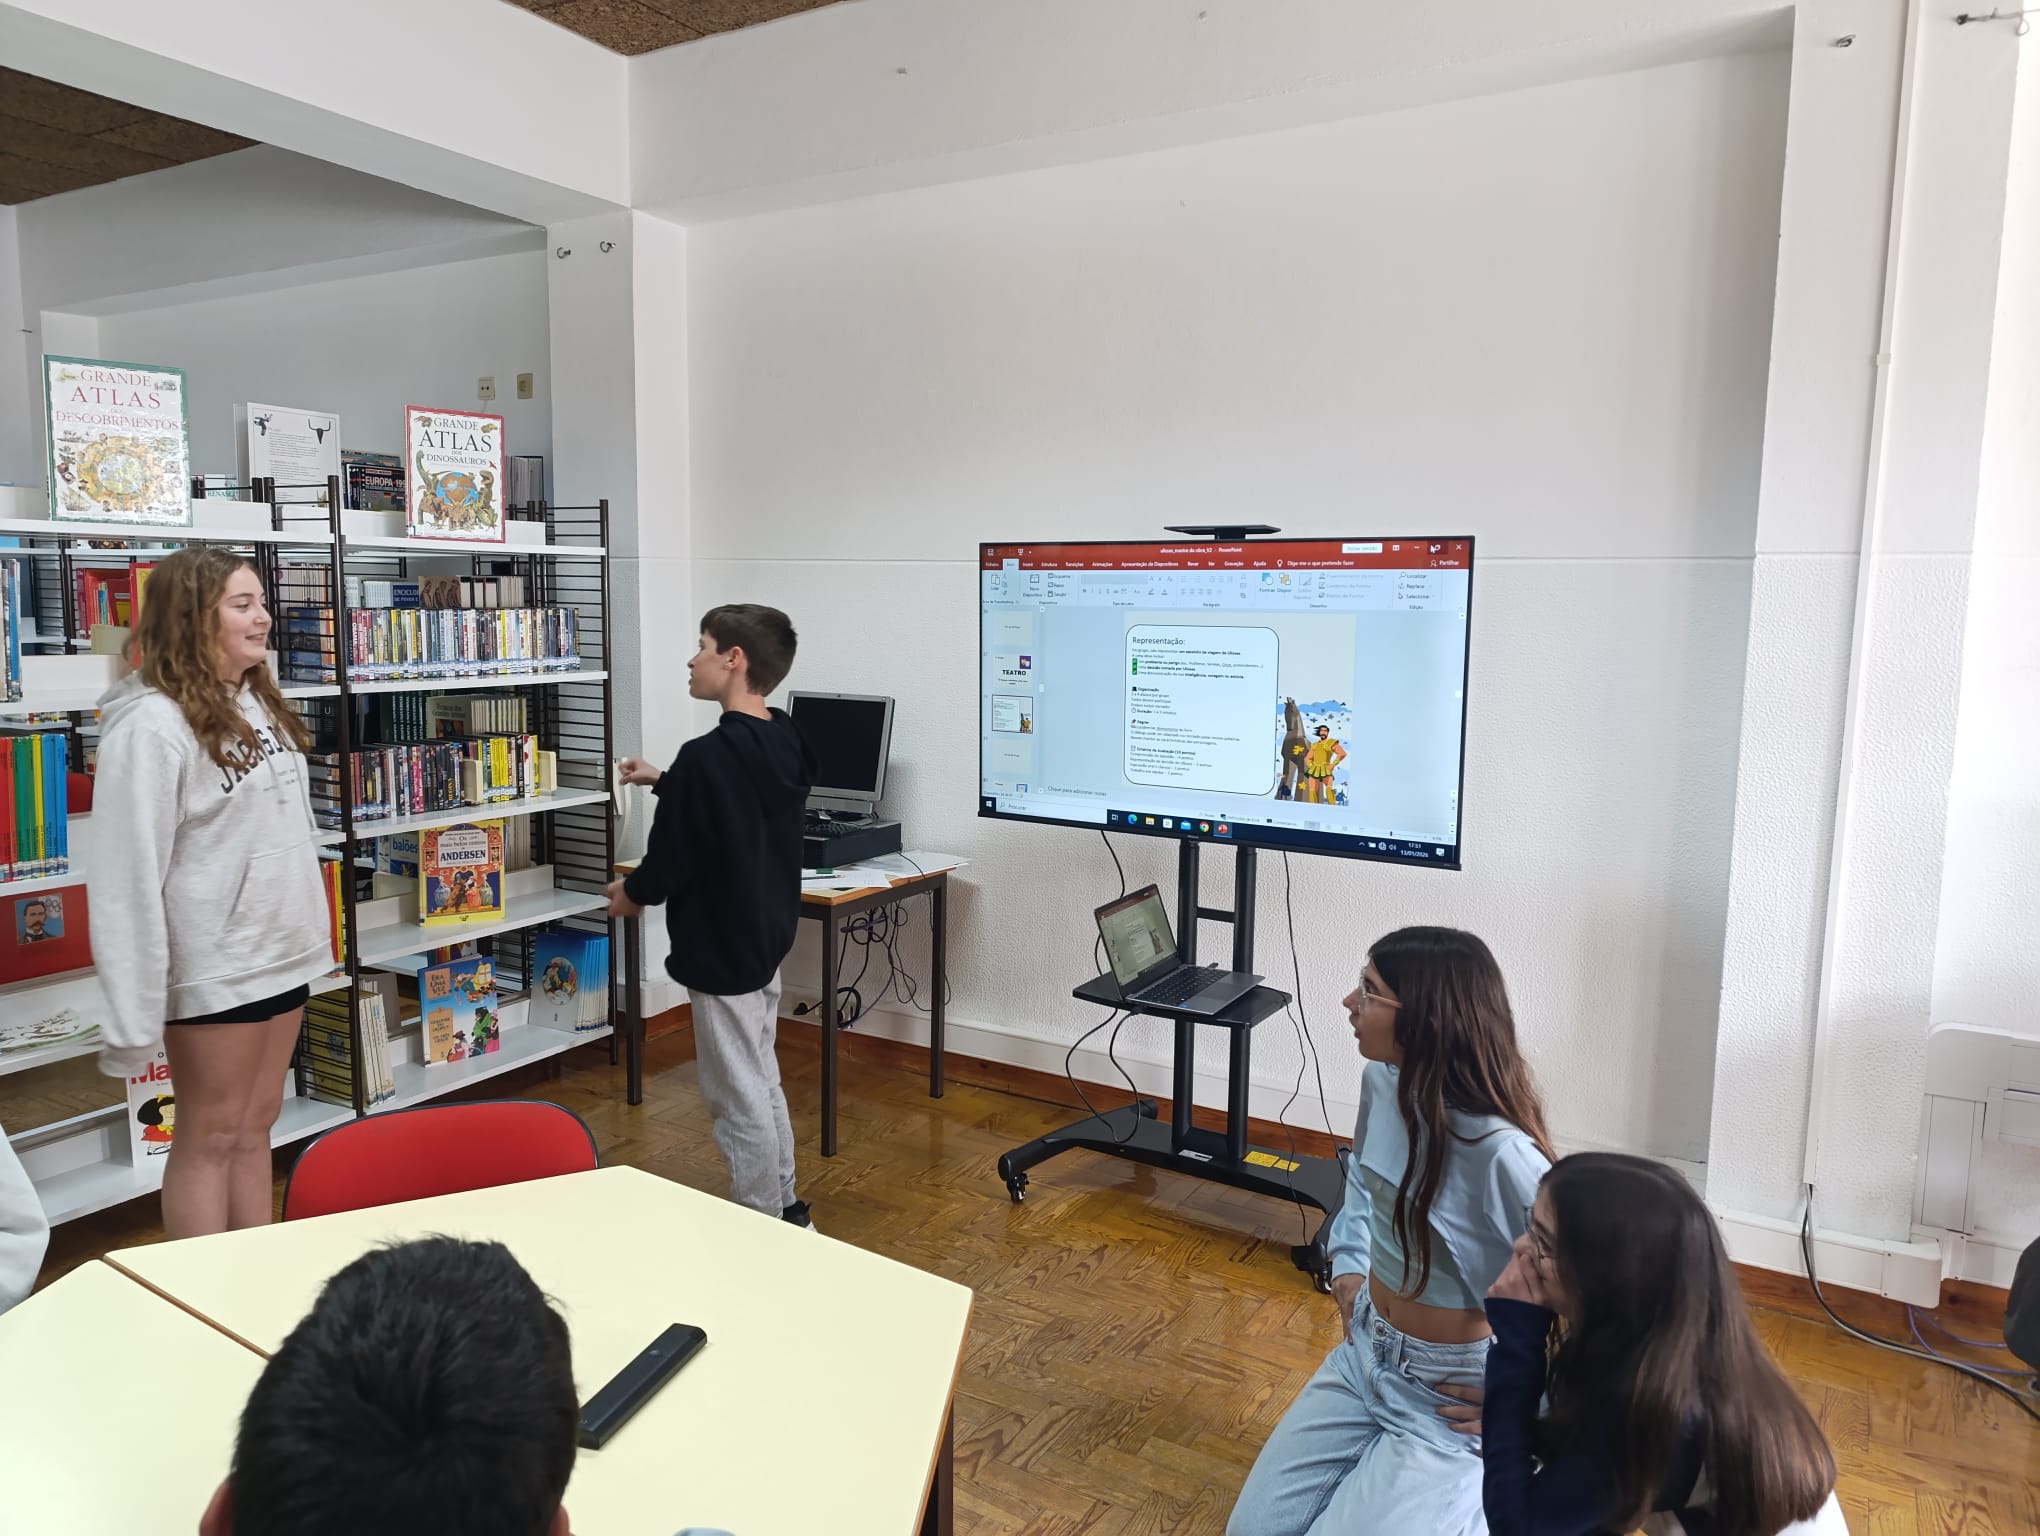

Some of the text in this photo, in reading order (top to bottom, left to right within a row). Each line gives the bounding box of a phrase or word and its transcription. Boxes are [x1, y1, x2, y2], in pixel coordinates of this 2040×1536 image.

[80, 369, 152, 387] GRANDE
[71, 386, 161, 409] ATLAS
[56, 411, 179, 430] DESCOBRIMENTOS
[433, 417, 479, 431] GRANDE
[418, 429, 492, 452] ATLAS
[426, 454, 487, 465] DINOSSAUROS
[365, 476, 393, 486] EUROPA
[394, 588, 419, 596] ENCICLO
[1132, 636, 1186, 646] Representação:
[440, 849, 486, 861] ANDERSEN
